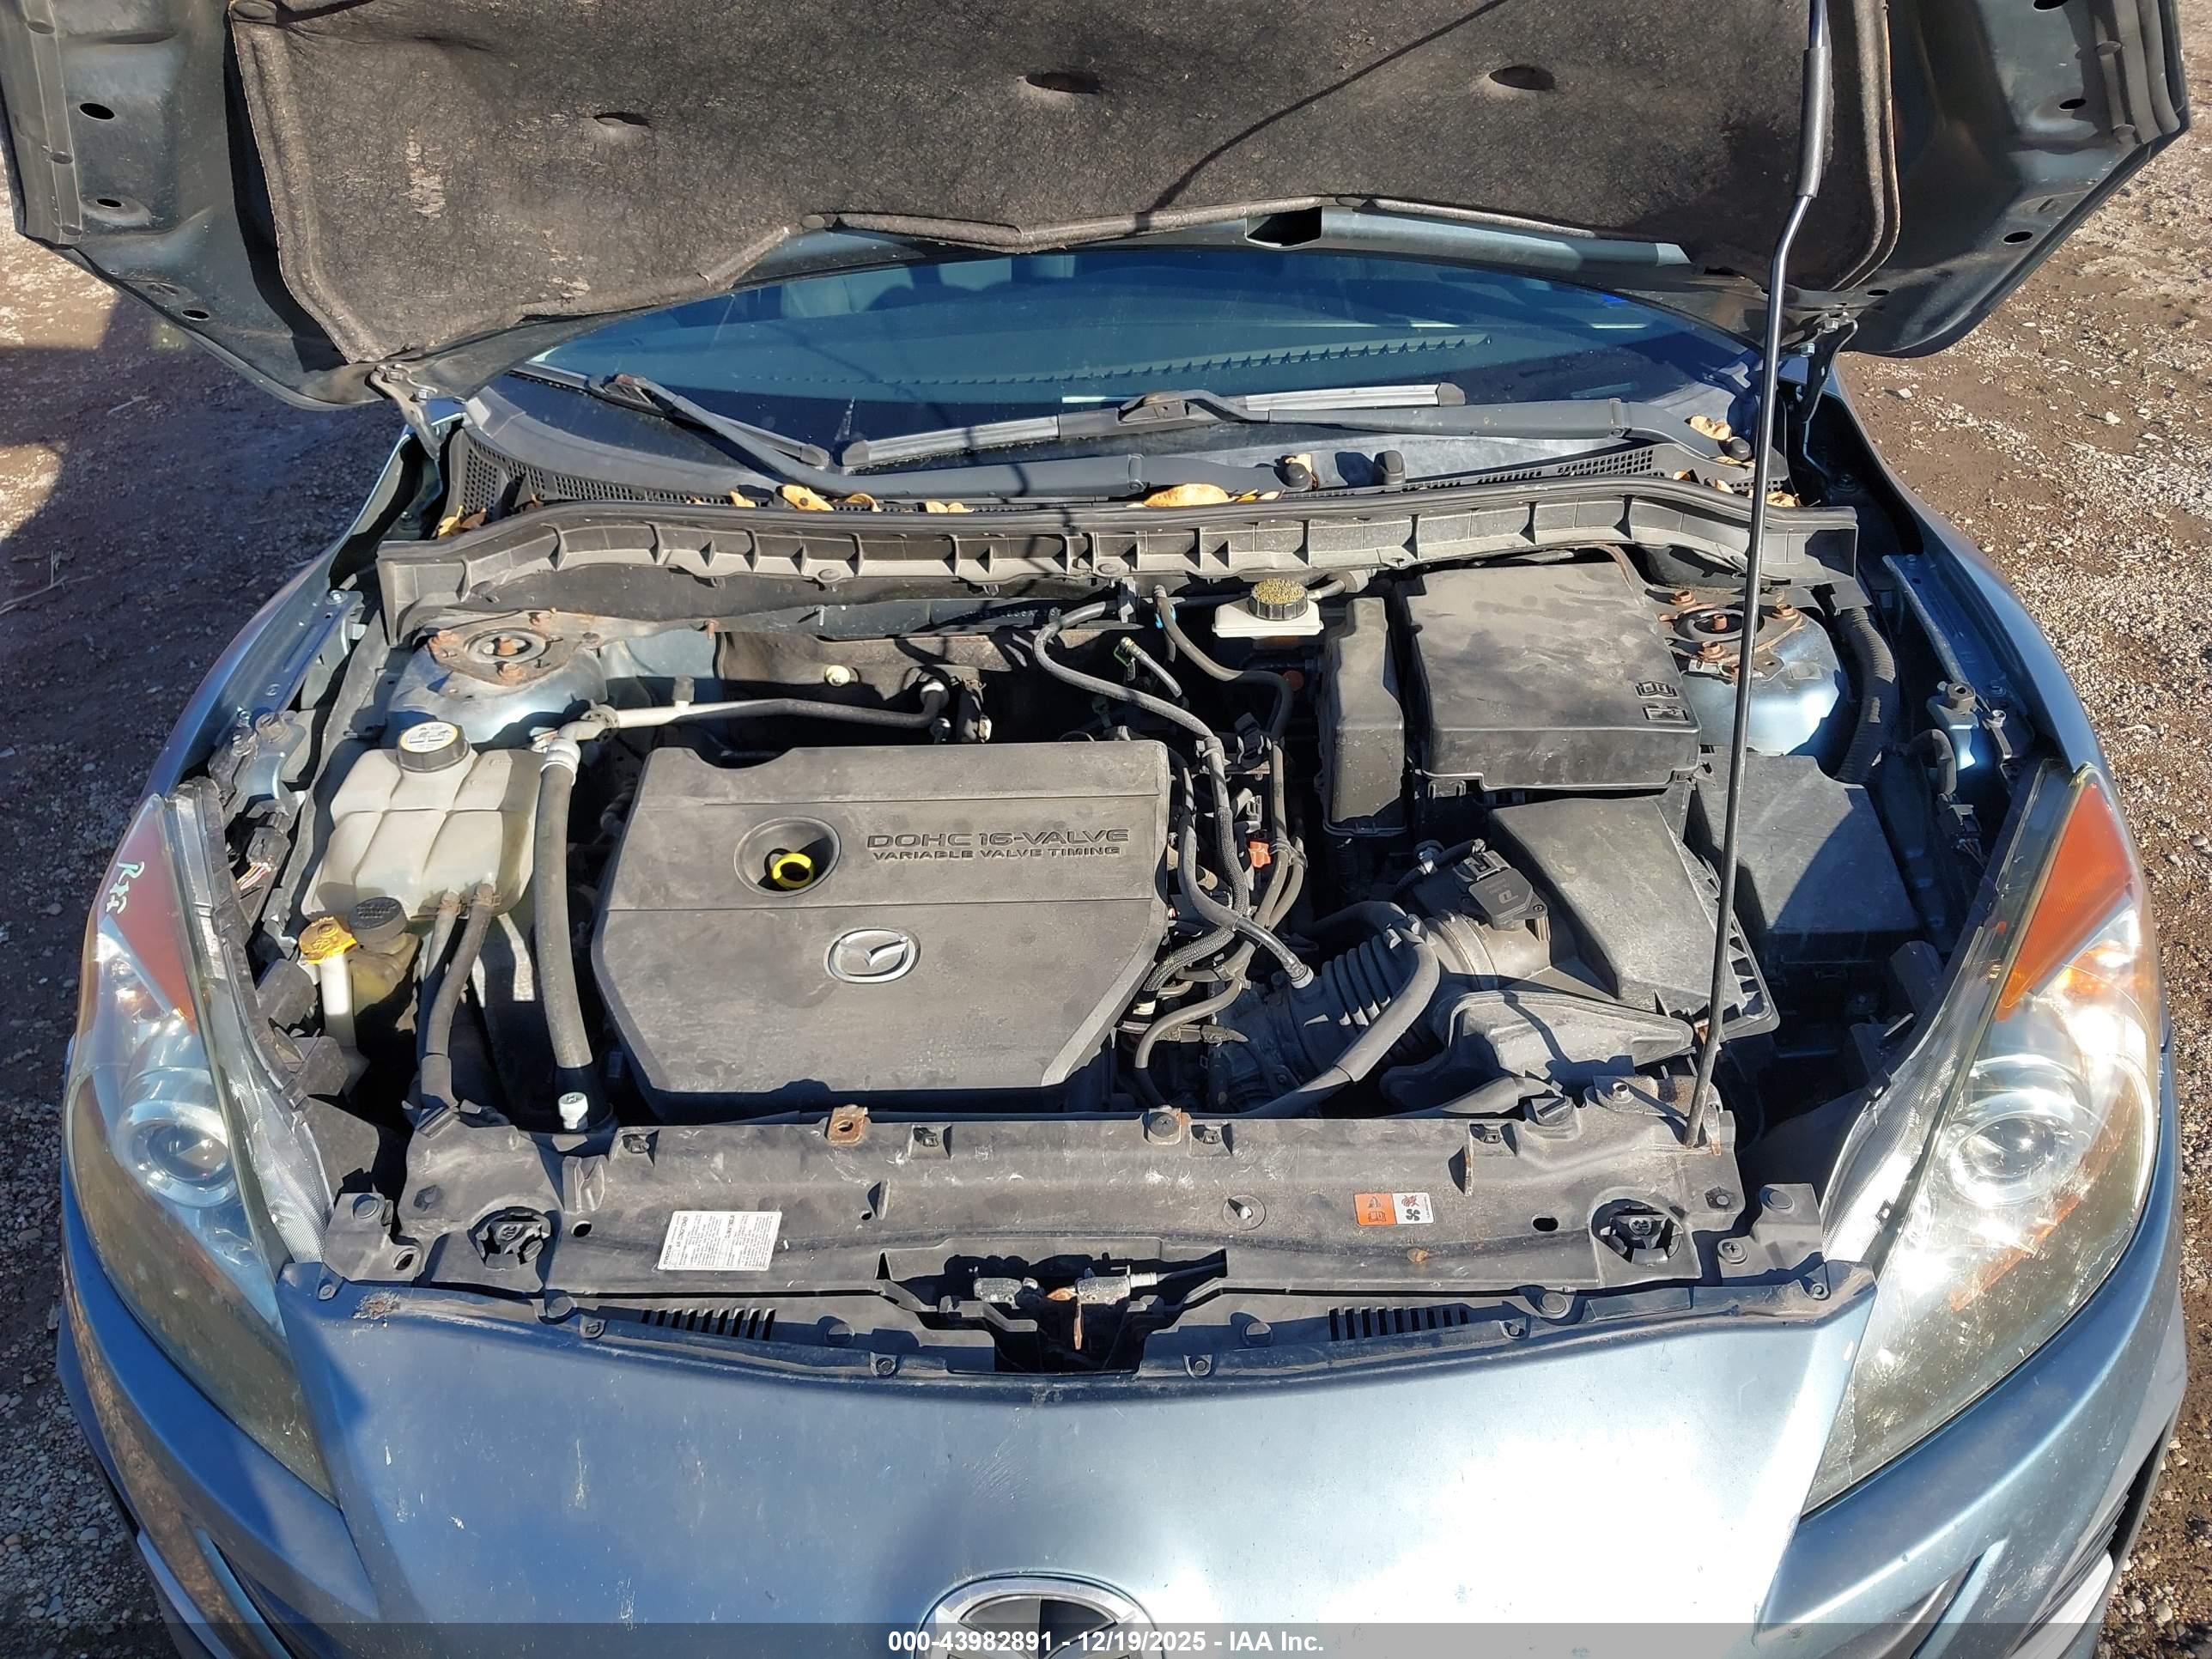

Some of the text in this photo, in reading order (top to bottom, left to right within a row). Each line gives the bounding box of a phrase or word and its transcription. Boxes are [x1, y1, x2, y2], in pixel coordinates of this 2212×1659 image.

[866, 829, 1130, 848] DOHC 16-VALVE
[872, 846, 1121, 860] VARIABLE VALVE TIMING
